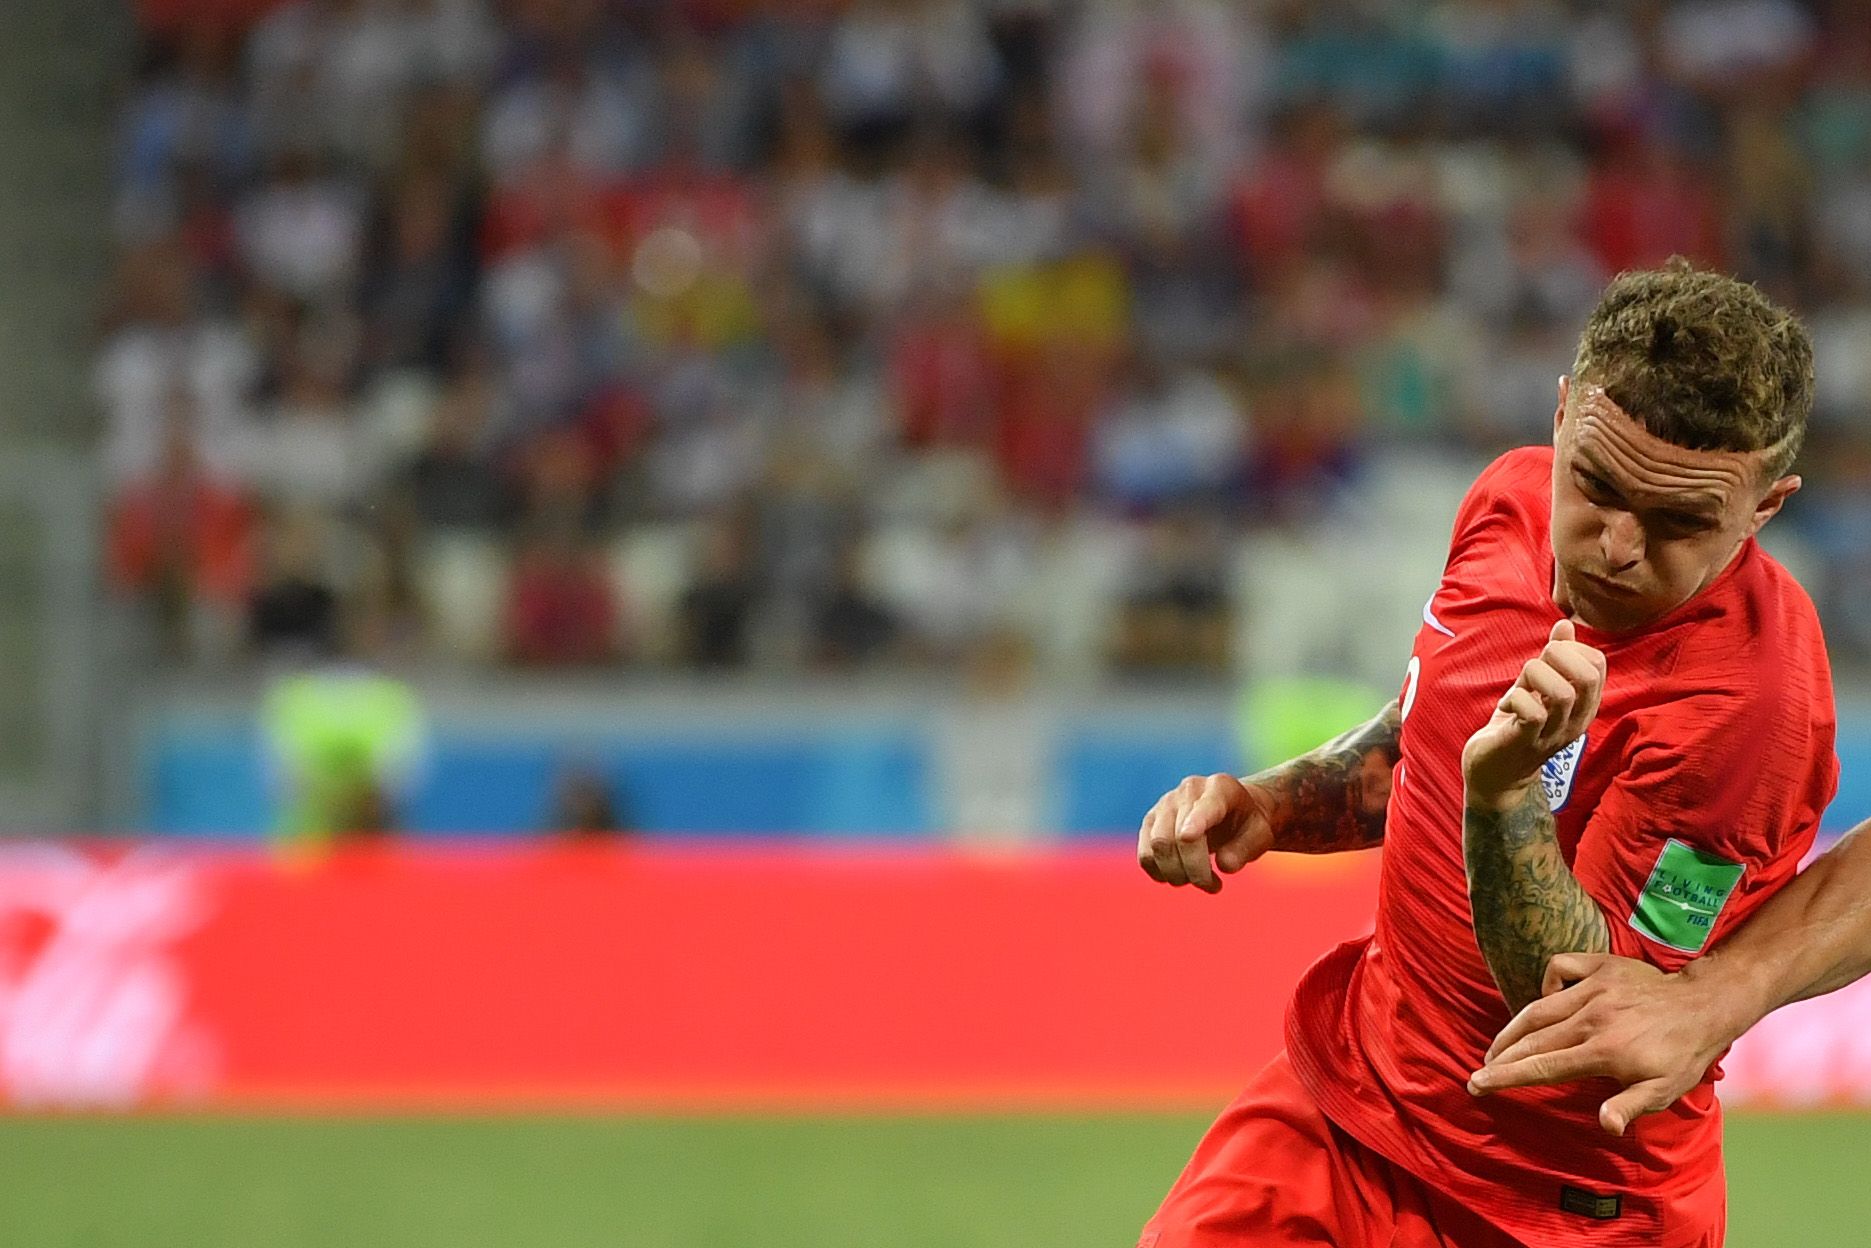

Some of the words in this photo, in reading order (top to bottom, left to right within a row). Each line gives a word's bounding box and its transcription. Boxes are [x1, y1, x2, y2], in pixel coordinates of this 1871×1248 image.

[1653, 880, 1719, 908] FOOTBALL
[1659, 869, 1726, 898] LIVING
[1686, 913, 1711, 927] FIFA
